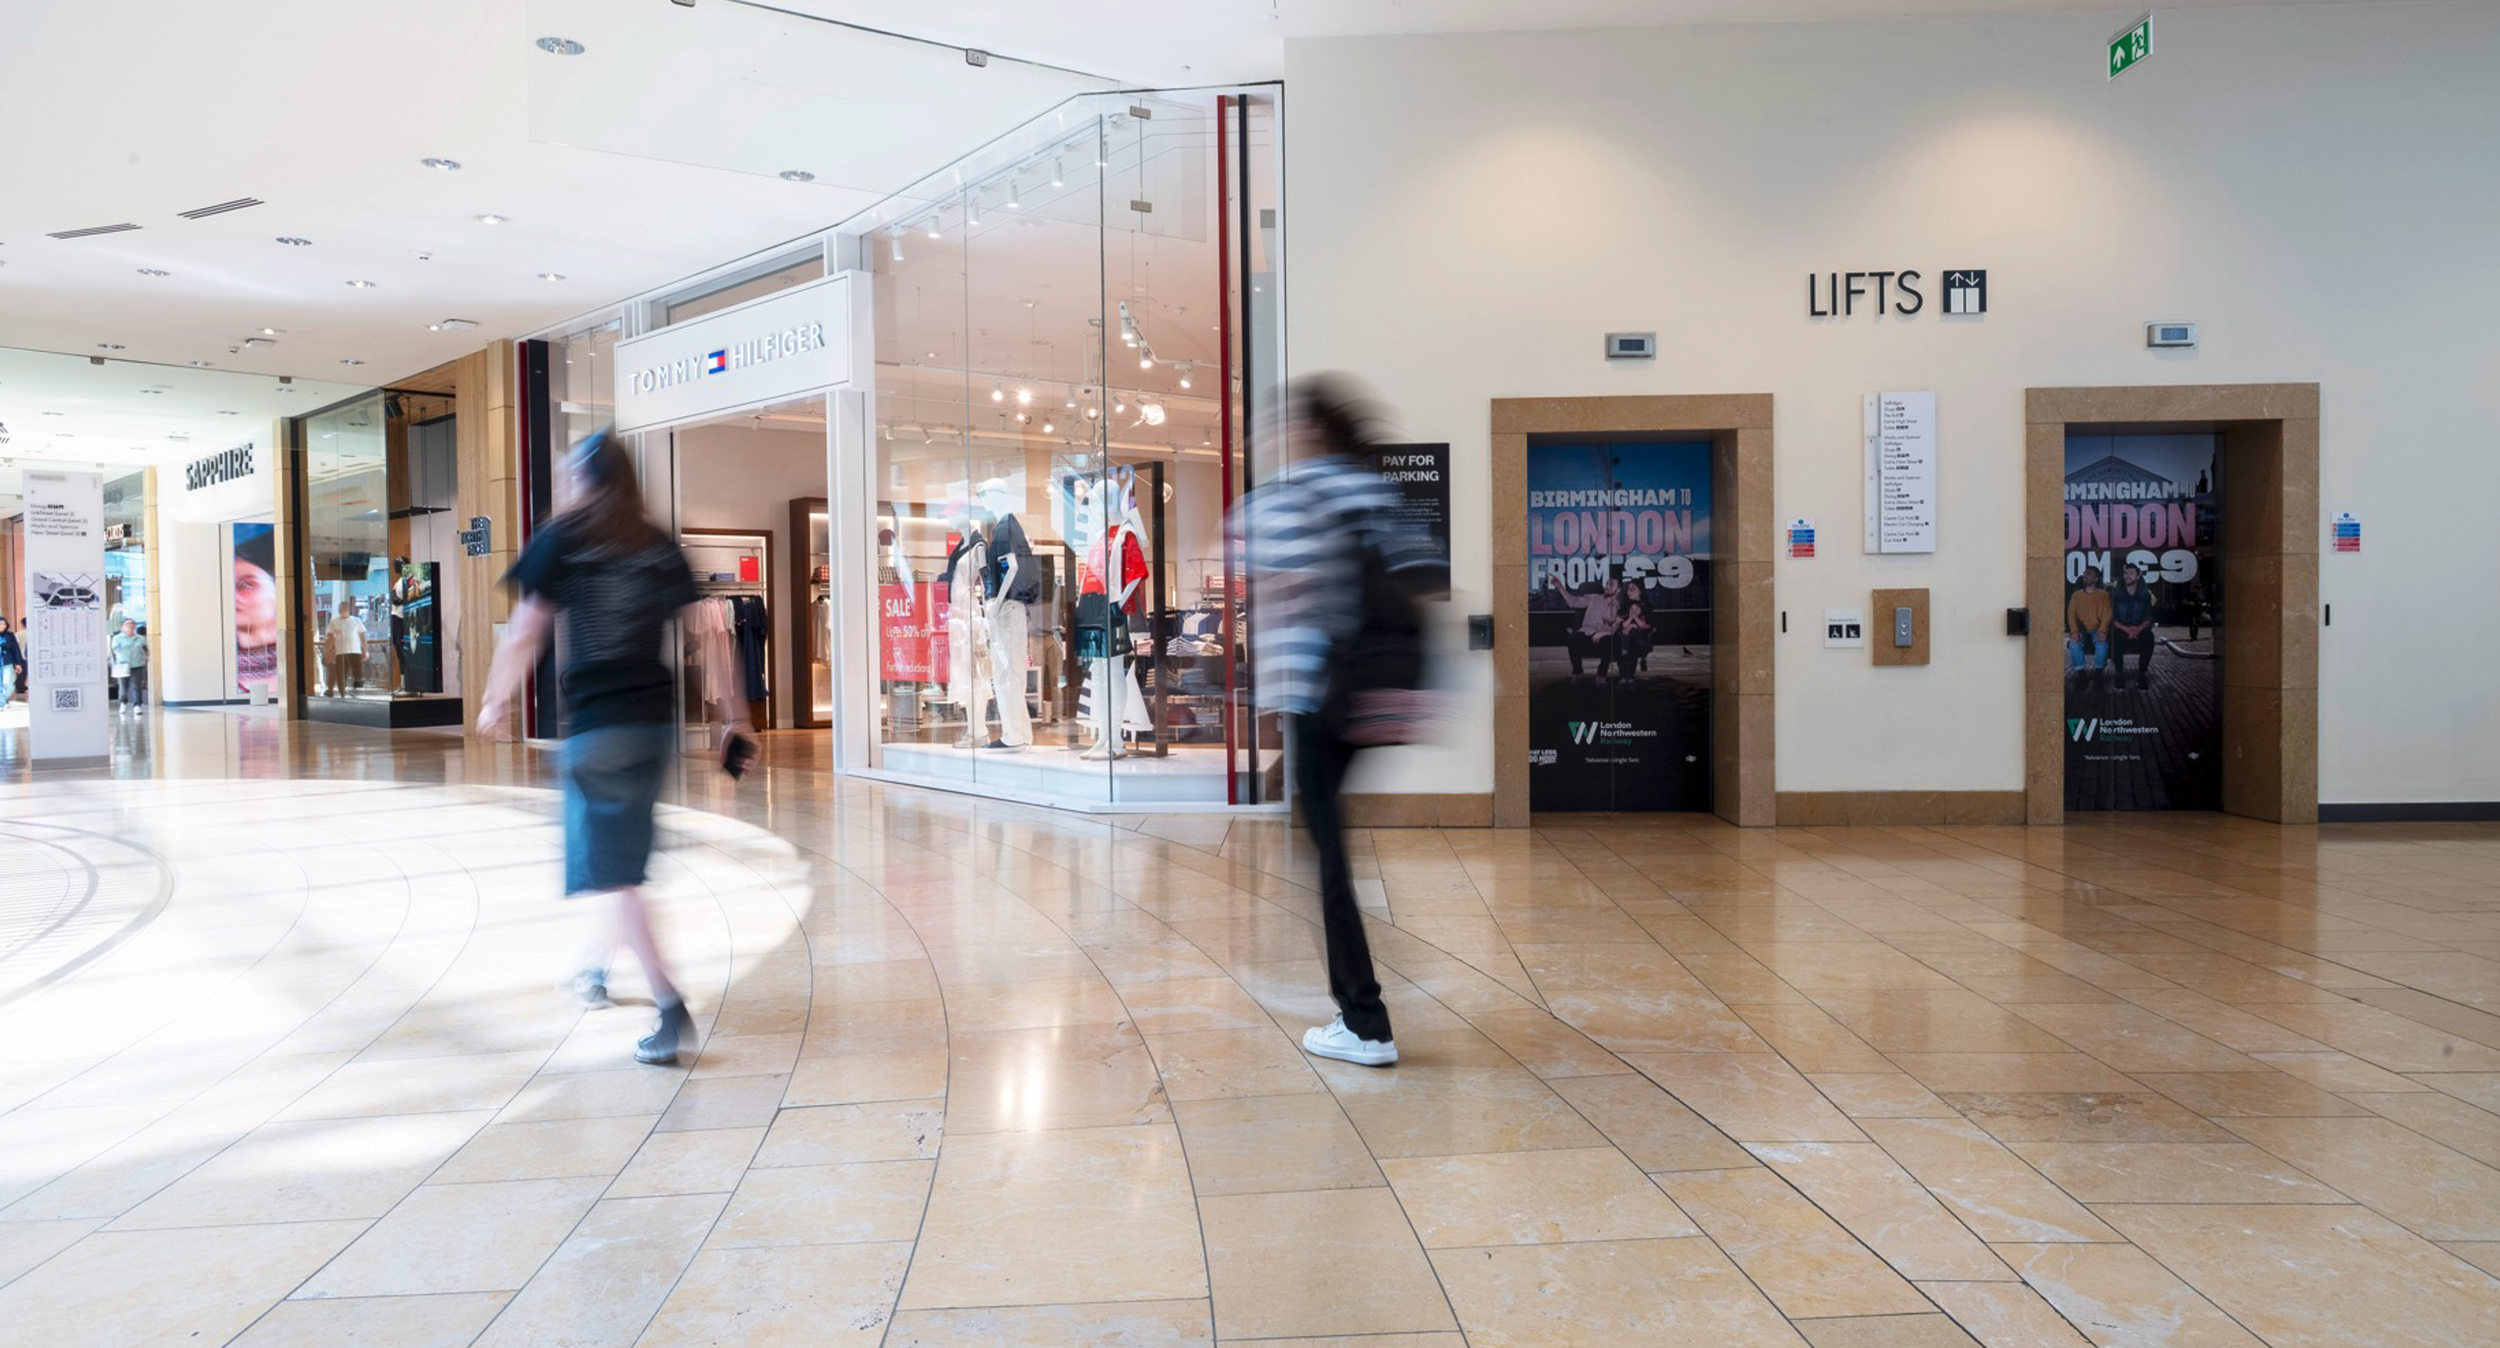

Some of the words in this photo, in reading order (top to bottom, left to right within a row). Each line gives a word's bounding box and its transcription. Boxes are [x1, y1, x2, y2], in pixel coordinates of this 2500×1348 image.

[1809, 270, 1923, 316] LIFTS
[629, 354, 704, 395] TOMMY
[732, 323, 825, 370] HILFIGER
[186, 443, 254, 491] SAPPHIRE
[1382, 455, 1406, 467] PAY
[1408, 455, 1435, 466] FOR
[1382, 470, 1440, 482] PARKING
[1530, 488, 1675, 508] BIRMINGHAM
[1680, 488, 1692, 506] TO
[471, 517, 483, 530] THE
[461, 531, 482, 545] NORTH
[1531, 510, 1692, 555] LONDON
[467, 543, 485, 557] FACE
[1532, 557, 1610, 590] FROM
[885, 598, 911, 618] SALE
[903, 625, 920, 638] 50%
[1600, 721, 1632, 729] London
[2100, 718, 2133, 726] London
[1600, 729, 1657, 737] Northwestern
[2100, 726, 2159, 734] Northwestern
[1600, 737, 1632, 746] Railway
[1538, 755, 1557, 764] MORE
